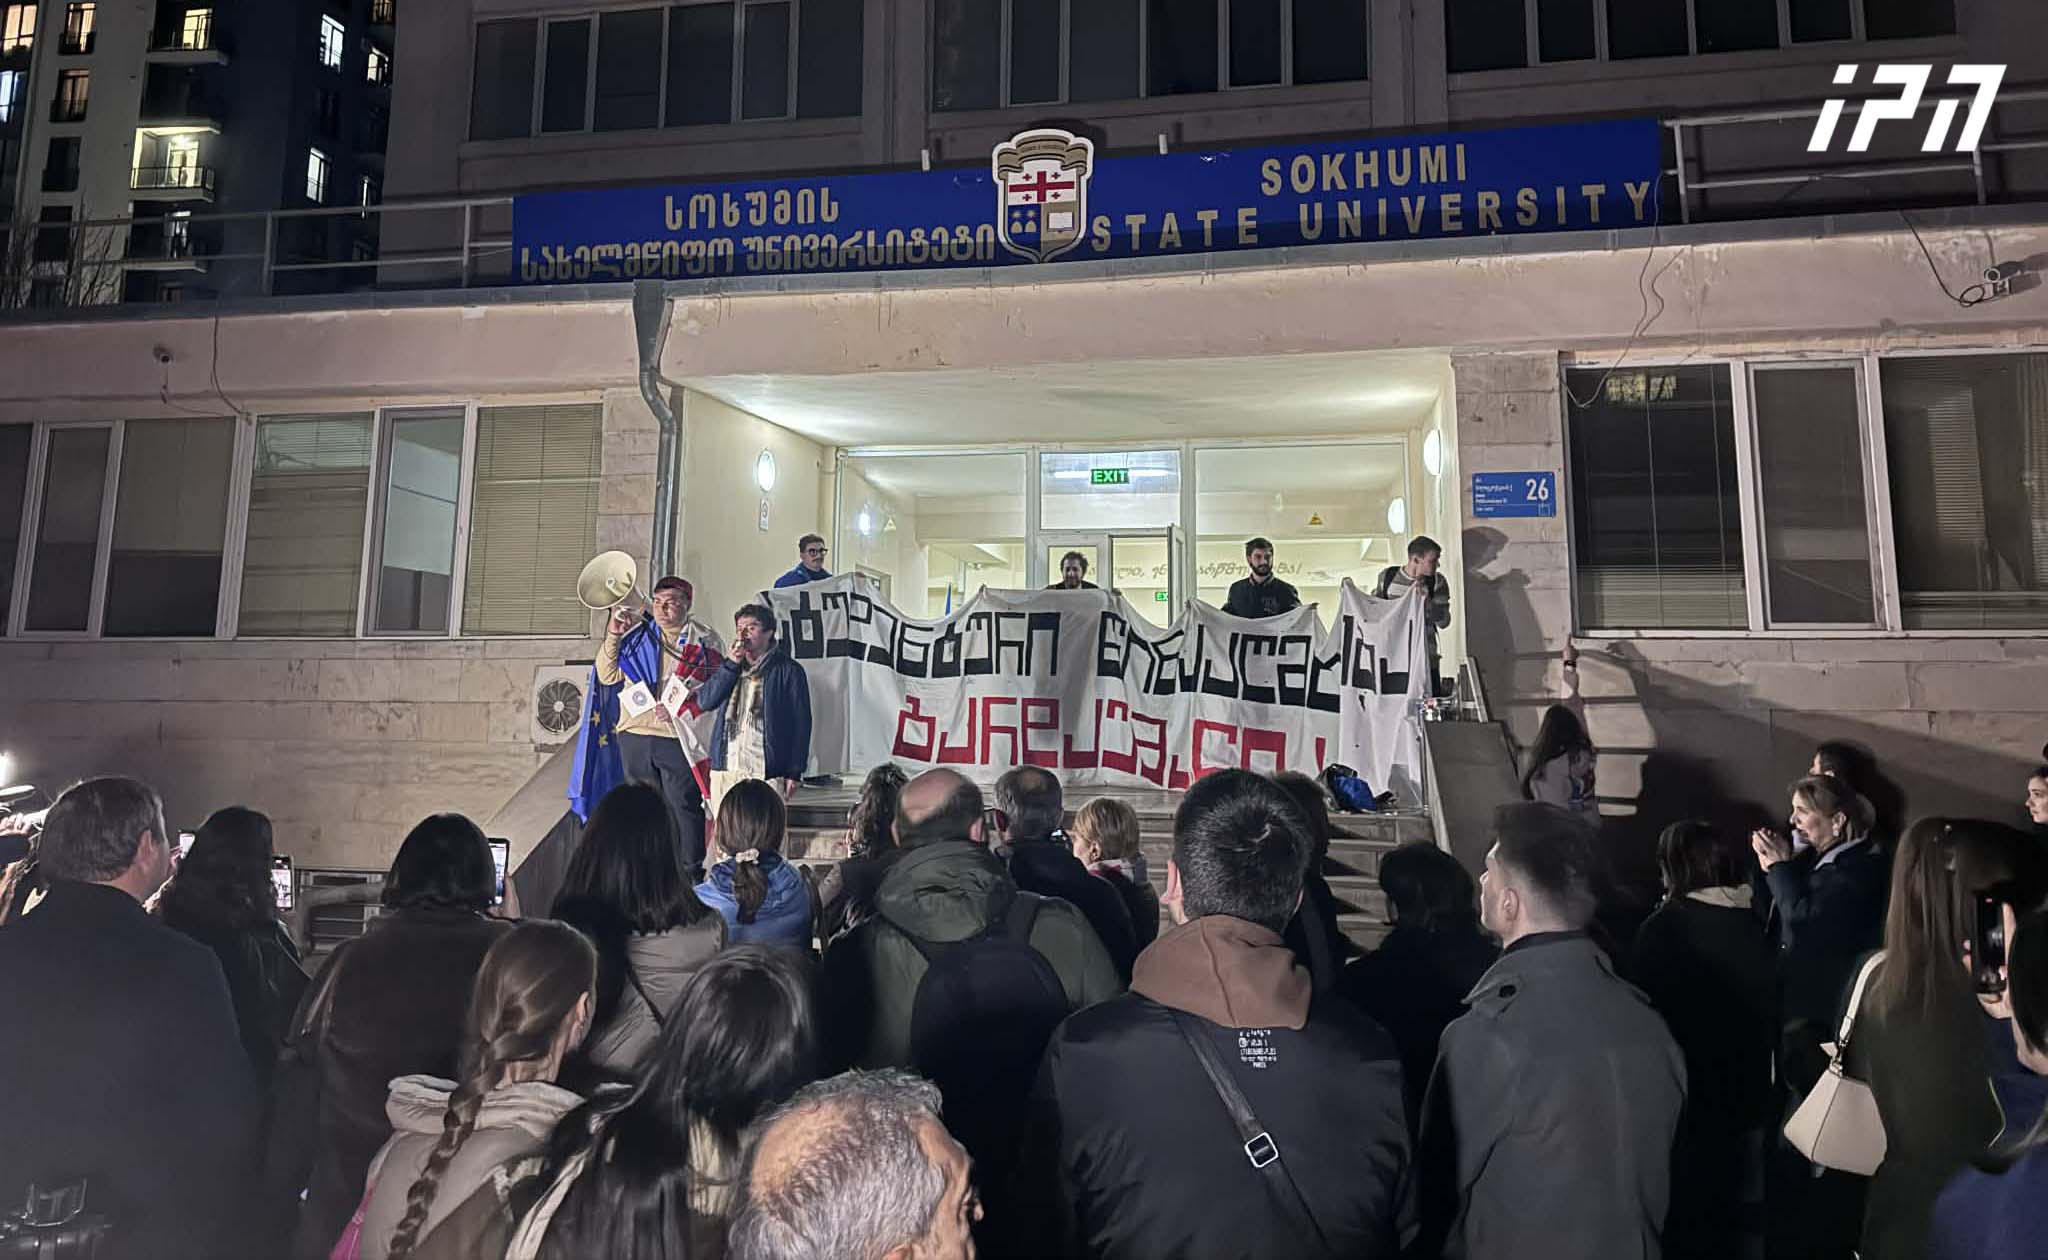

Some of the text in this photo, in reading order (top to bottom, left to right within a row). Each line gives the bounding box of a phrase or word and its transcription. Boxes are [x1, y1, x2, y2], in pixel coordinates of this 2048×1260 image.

[1261, 144, 1467, 196] SOKHUMI
[665, 187, 839, 231] სოხუმის
[1091, 181, 1651, 252] STATE UNIVERSITY
[520, 223, 995, 282] სახელმწიფო უნივერსიტეტი
[1093, 470, 1127, 482] EXIT
[1525, 478, 1549, 500] 26
[892, 694, 1327, 790] გარდაუვალი
